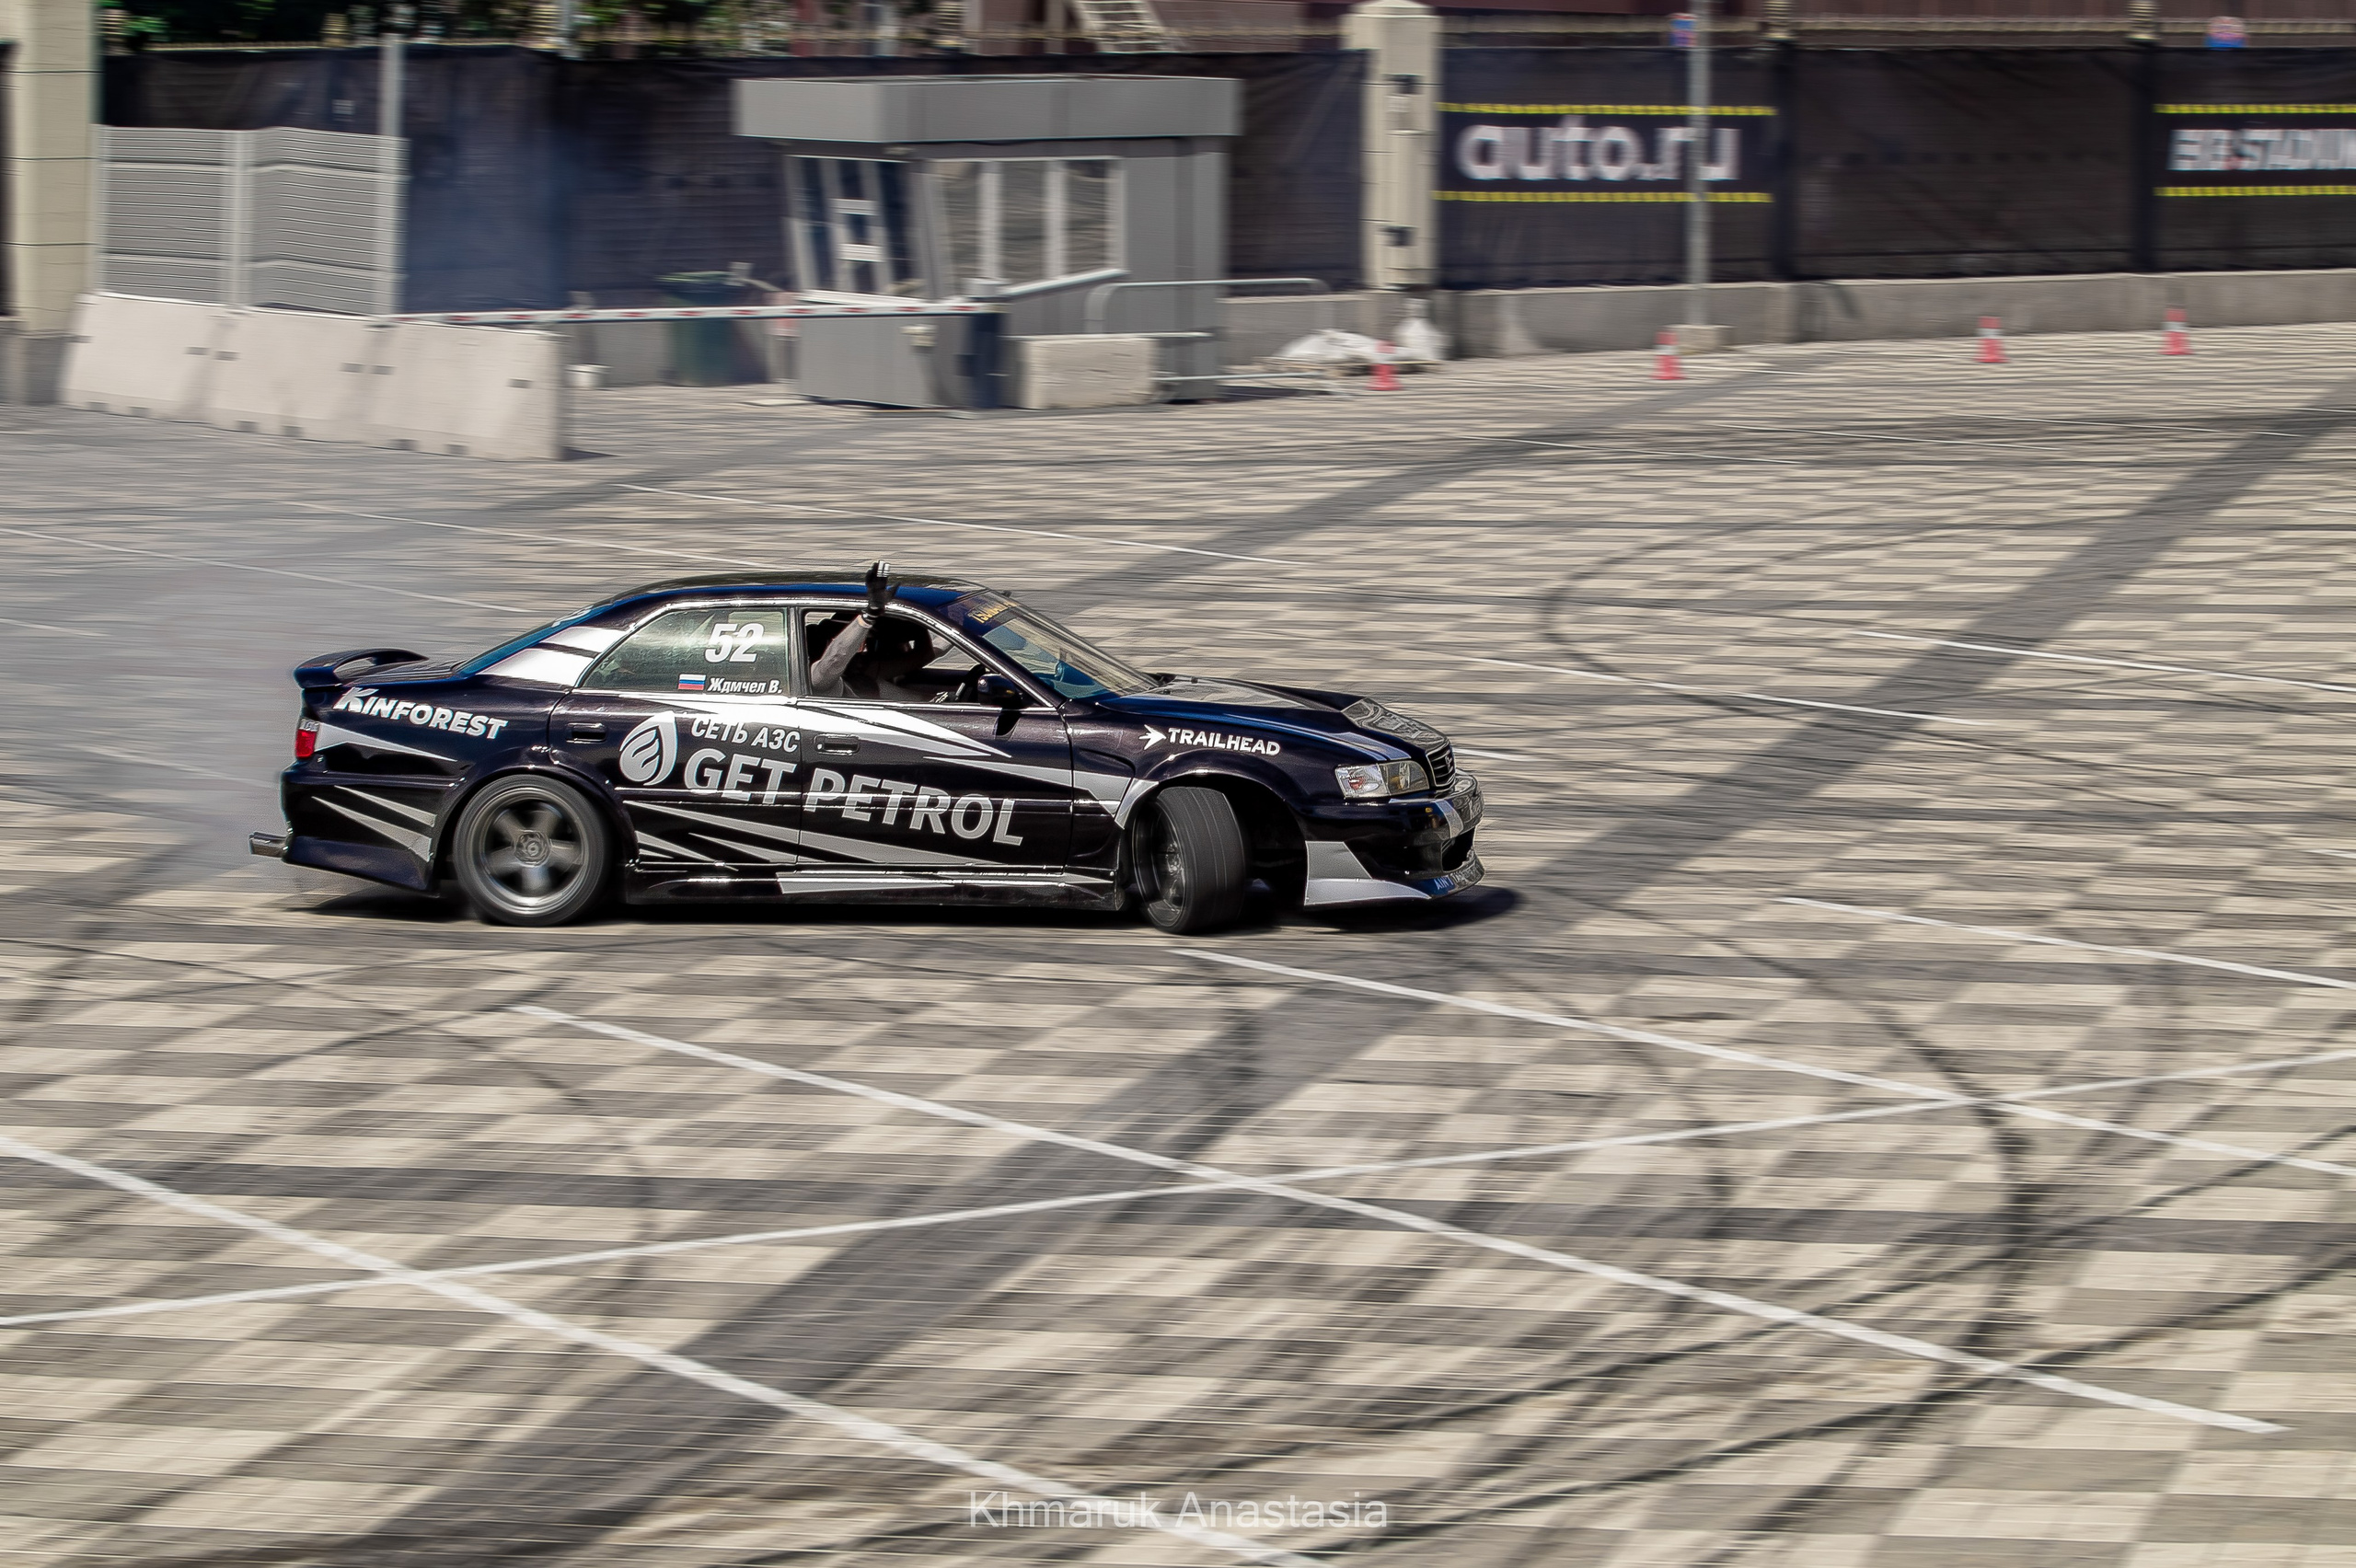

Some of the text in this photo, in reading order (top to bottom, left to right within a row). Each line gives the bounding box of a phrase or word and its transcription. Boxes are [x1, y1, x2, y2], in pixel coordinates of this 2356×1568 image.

[1457, 115, 1741, 180] auto.ru
[705, 623, 765, 663] 52
[332, 686, 509, 739] KINFOREST
[691, 718, 749, 744] СЕТЬ
[1168, 727, 1281, 755] TRAILHEAD
[684, 748, 1023, 846] GET PETROL
